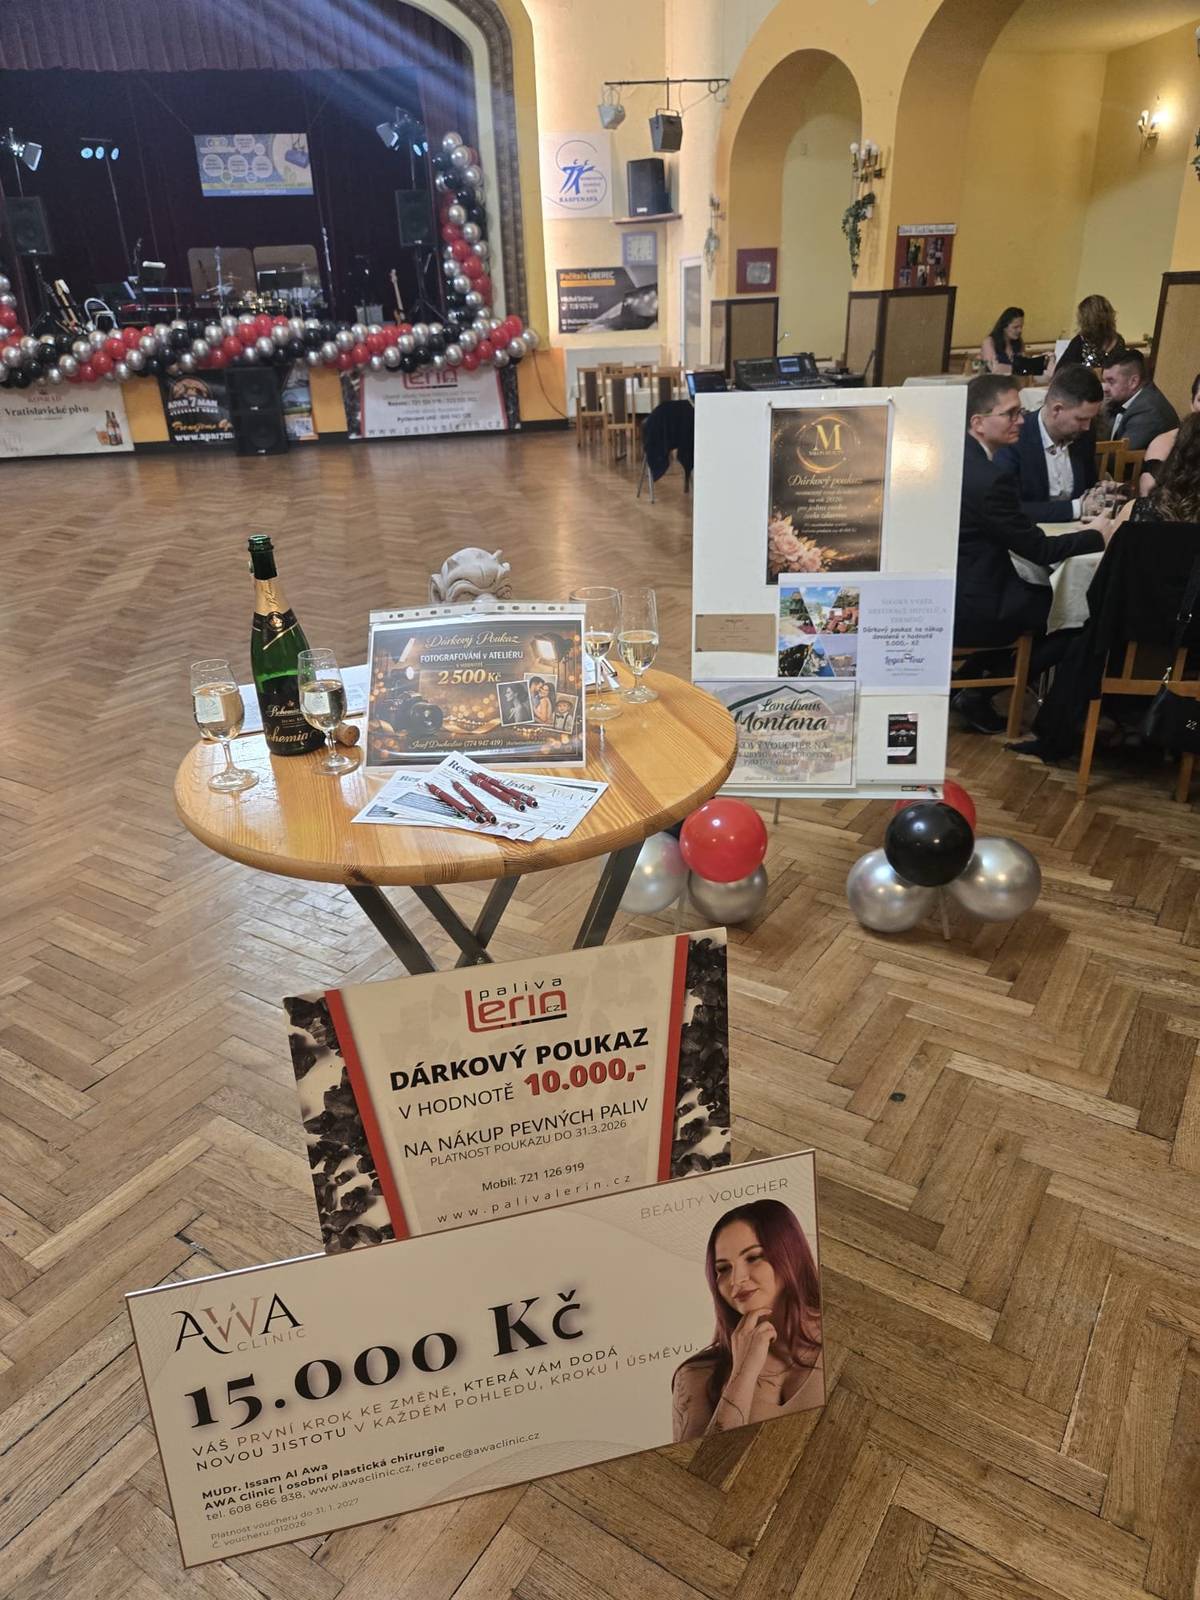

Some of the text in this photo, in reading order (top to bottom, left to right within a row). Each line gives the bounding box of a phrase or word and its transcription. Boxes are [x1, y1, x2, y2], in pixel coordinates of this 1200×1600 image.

[4, 404, 89, 417] Vratislavické pivo
[811, 424, 842, 451] M
[787, 472, 864, 489] Dárkový poukaz
[420, 651, 480, 663] FOTOGRAFOVÁNÍ
[489, 650, 524, 659] ATELIÉRU
[425, 631, 521, 649] Dárkový Poukaz
[488, 671, 502, 683] Kč
[734, 710, 828, 734] Montana
[759, 698, 822, 712] Landhaus
[765, 742, 812, 750] VOUCHER
[479, 976, 562, 1001] paliva
[464, 989, 568, 1033] Lerin
[390, 1027, 649, 1091] DÁRKOVÝ POUKAZ
[398, 1057, 646, 1120] V HODNOTĚ 10.000,-
[403, 1098, 648, 1158] NA NÁKUP PEVNÝCH PALIV
[430, 1118, 628, 1166] PLATNOST POUKAZU DO 31.3.2026
[482, 1162, 585, 1192] Mobil: 721 126 919
[437, 1174, 632, 1224] www.palivalerin.cz
[640, 1178, 788, 1220] BEAUTY VOUCHER
[171, 1292, 304, 1354] AWA
[236, 1328, 307, 1352] CLINIC
[184, 1289, 584, 1430] 15.000 Kč
[192, 1345, 618, 1457] VÁŠ PRVNÍ KROK KE ZMĚNĚ, KTERÁ VÁM DODÁ
[196, 1447, 264, 1472] NOVOU
[272, 1427, 346, 1454] JISTOTU
[354, 1422, 366, 1434] V
[374, 1402, 447, 1429] KAŽDÉM
[454, 1380, 544, 1410] POHLEDU,
[550, 1364, 608, 1386] KROKU
[626, 1343, 698, 1367] ÚSMĚVU.
[202, 1463, 329, 1500] MUDr. Issam Al Awa
[204, 1496, 236, 1510] AWA
[240, 1487, 276, 1502] Clinic
[286, 1472, 328, 1490] osobní
[332, 1458, 387, 1482] plastická
[390, 1444, 446, 1465] chirurgie
[228, 1503, 252, 1516] 608
[255, 1498, 278, 1510] 686
[280, 1491, 306, 1503] 838,
[308, 1464, 414, 1497] www.awaclinic.cz,
[416, 1432, 540, 1470] recepce@awaclinic.cz
[211, 1525, 255, 1540] Platnost
[254, 1514, 298, 1530] voucheru
[300, 1510, 312, 1518] do
[336, 1497, 360, 1510] 2027
[224, 1529, 272, 1546] voucheru:
[274, 1520, 306, 1534] 012026
